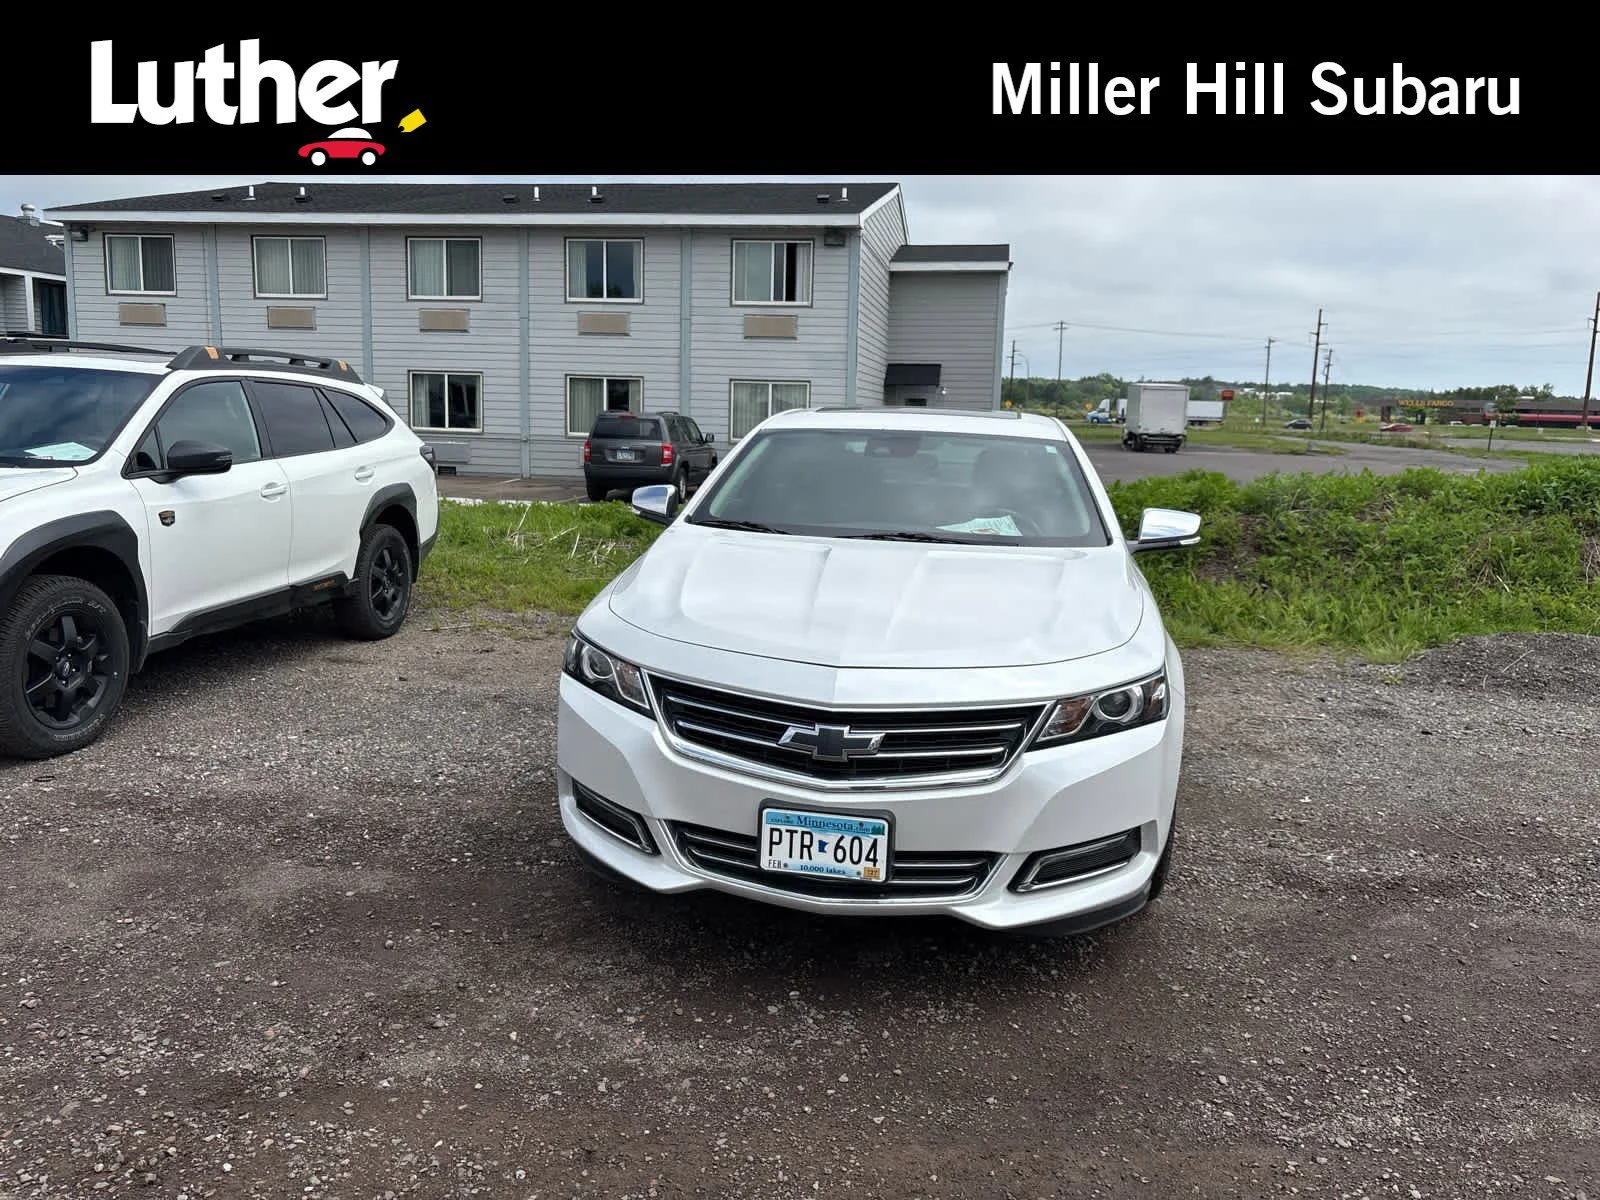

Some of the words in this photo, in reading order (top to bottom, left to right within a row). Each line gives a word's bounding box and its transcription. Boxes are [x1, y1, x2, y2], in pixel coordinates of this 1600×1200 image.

[797, 815, 854, 831] Minnesota
[768, 827, 814, 860] PTR
[833, 835, 879, 867] 604
[800, 864, 825, 873] 10,000
